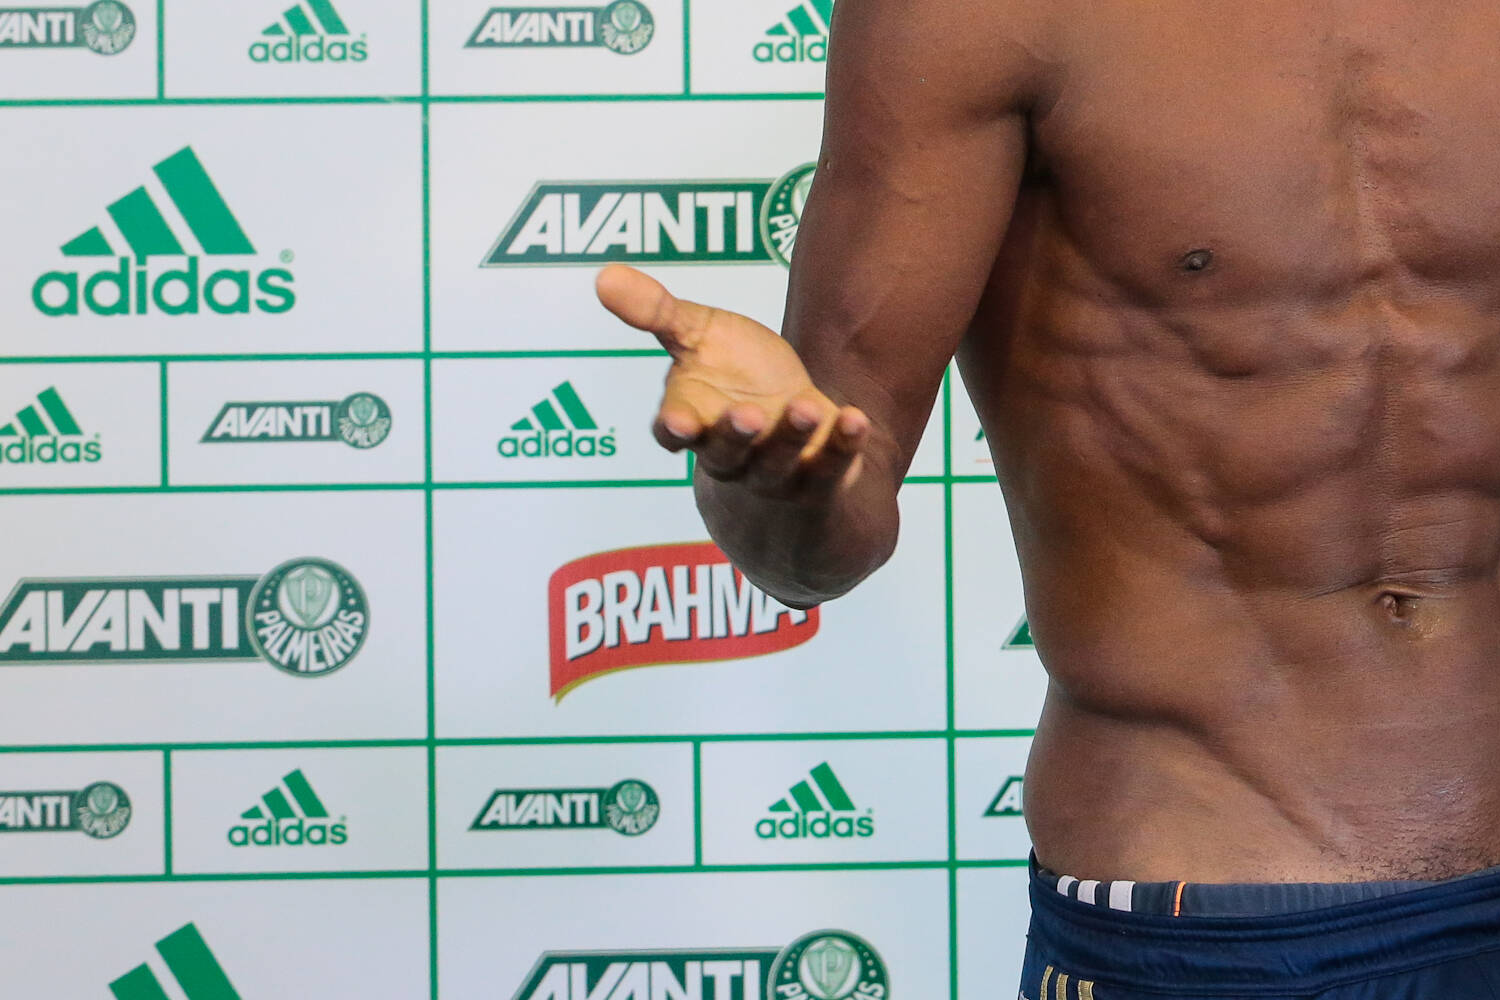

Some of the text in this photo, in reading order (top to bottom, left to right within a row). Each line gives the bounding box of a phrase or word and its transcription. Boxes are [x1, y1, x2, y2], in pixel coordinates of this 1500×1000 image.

[475, 11, 594, 41] AVANTI
[249, 32, 368, 63] adidas
[506, 192, 753, 255] AVANTI
[31, 256, 296, 317] adidas
[212, 406, 331, 438] AVANTI
[498, 427, 616, 458] adidas
[0, 587, 239, 651] AVANTI
[256, 608, 364, 672] PALMEIRAS
[479, 794, 599, 826] AVANTI
[756, 811, 874, 839] adidas
[228, 819, 348, 846] adidas
